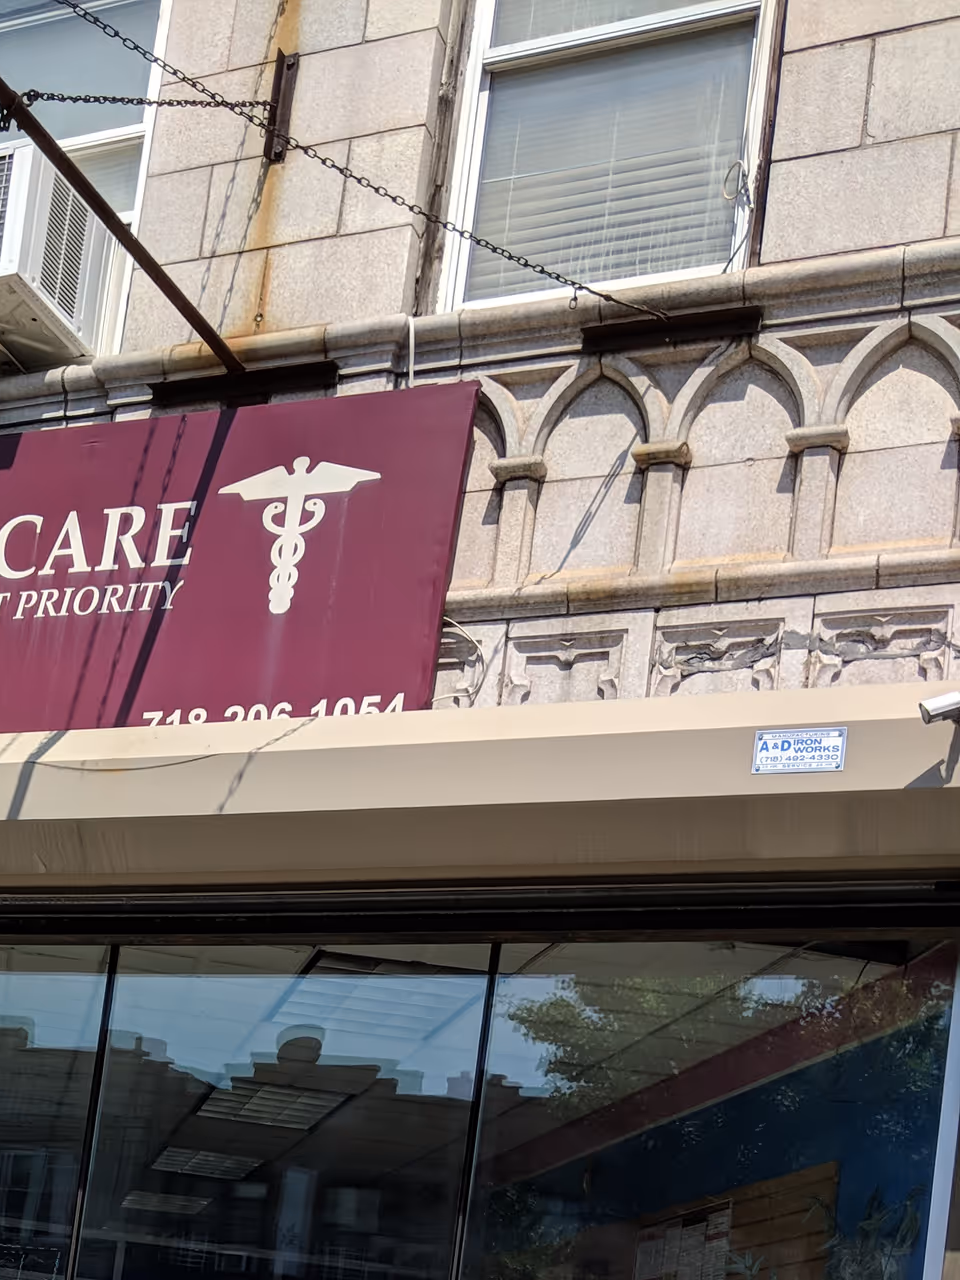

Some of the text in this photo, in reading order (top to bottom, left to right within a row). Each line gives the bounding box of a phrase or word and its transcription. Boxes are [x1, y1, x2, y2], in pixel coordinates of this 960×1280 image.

[17, 579, 184, 622] PRIORITY
[759, 740, 791, 752] A & D
[793, 738, 822, 746] IRON
[793, 745, 840, 753] WORKS
